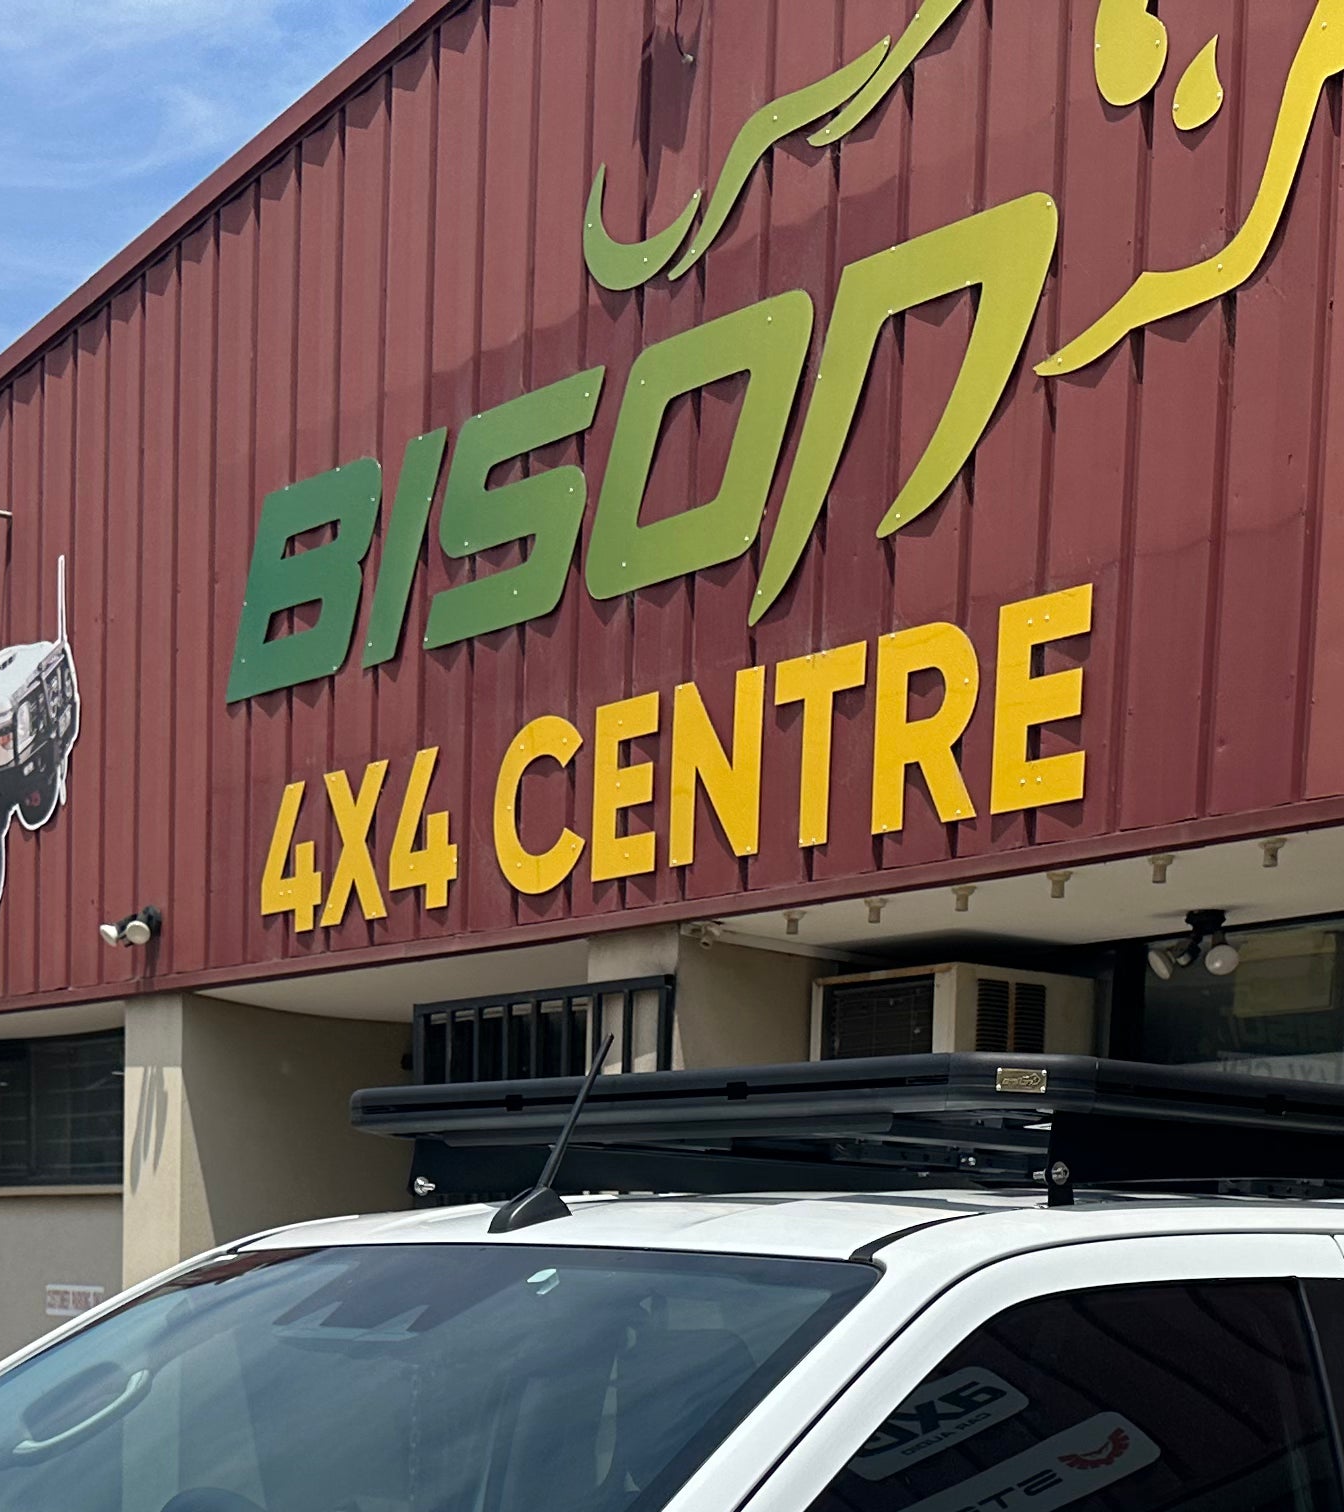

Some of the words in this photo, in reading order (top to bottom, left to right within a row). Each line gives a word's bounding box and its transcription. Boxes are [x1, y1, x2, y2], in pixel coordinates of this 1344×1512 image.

[225, 191, 1059, 704] BISON
[260, 746, 458, 933] 4X4
[493, 583, 1094, 895] CENTRE
